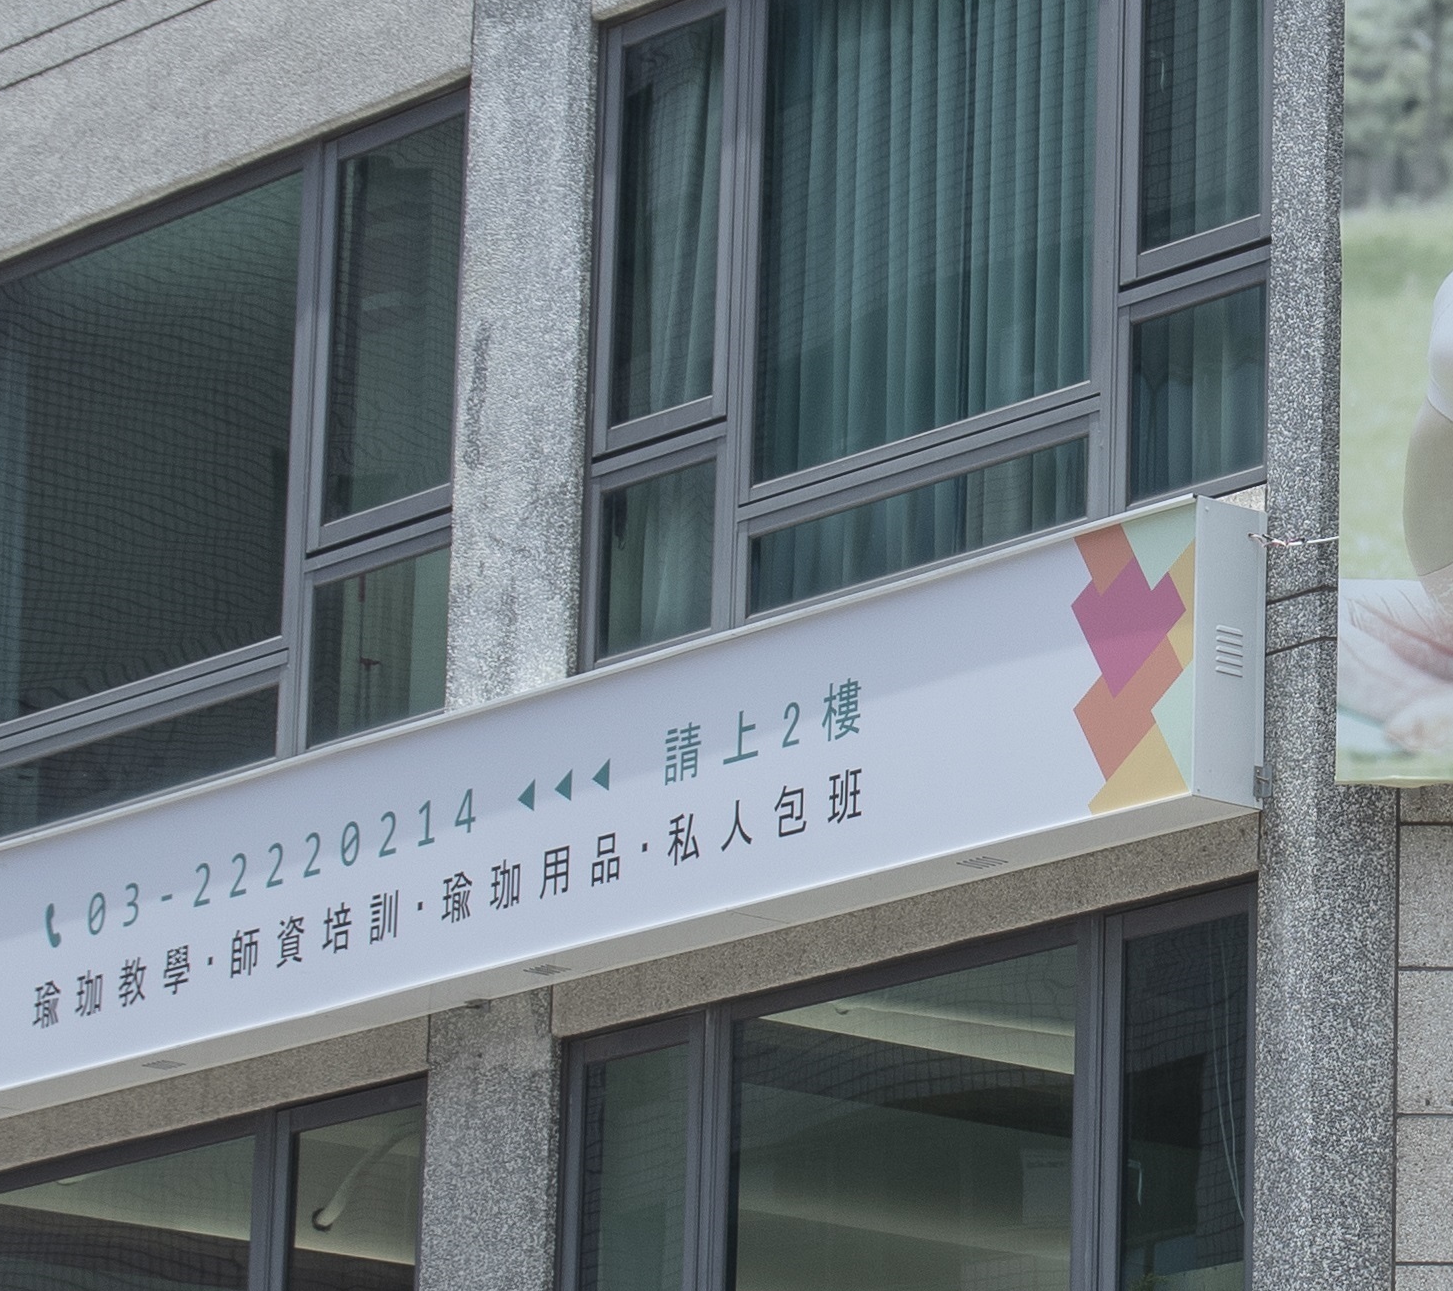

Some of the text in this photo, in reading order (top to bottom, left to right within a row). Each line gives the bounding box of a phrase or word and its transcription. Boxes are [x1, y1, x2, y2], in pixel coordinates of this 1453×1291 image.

[87, 678, 863, 936] 03-22220214 請上2樓
